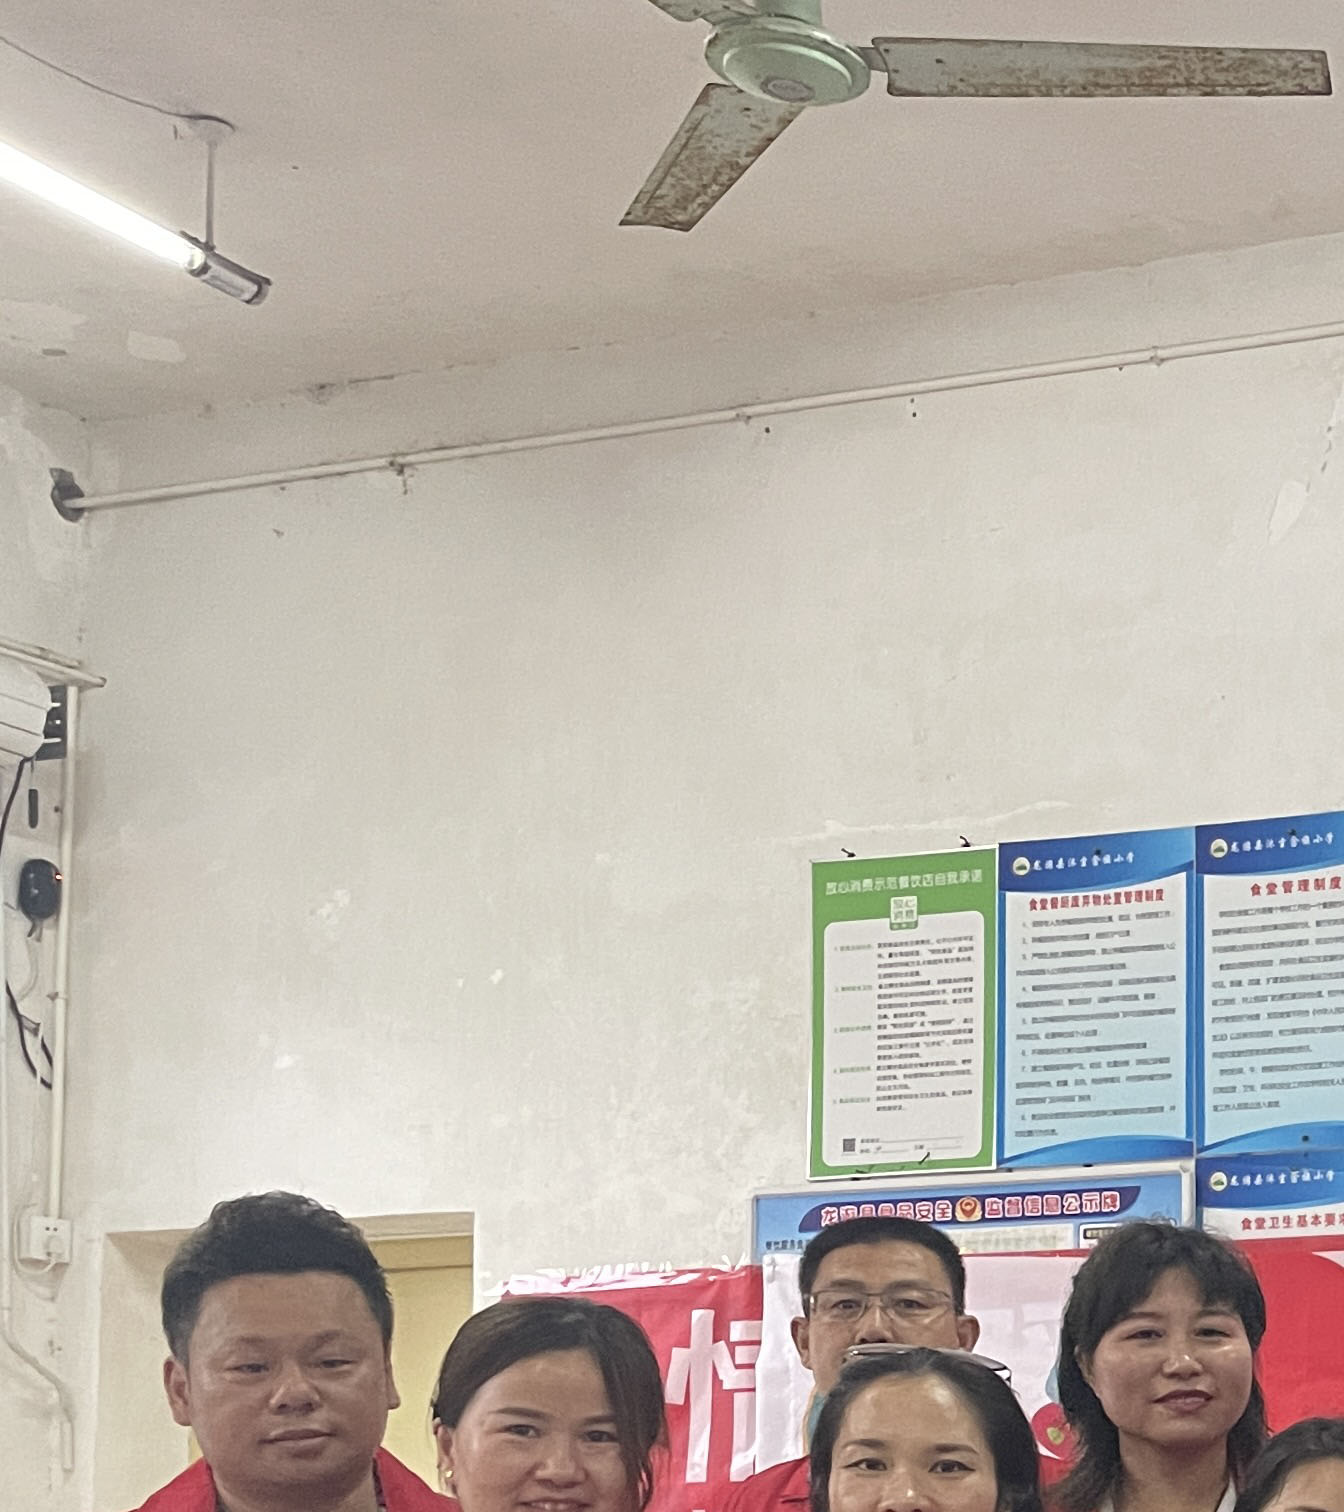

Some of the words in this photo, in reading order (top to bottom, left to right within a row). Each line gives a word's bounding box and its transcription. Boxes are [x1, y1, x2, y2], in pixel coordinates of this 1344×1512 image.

[1250, 876, 1343, 897] 食堂管理制度
